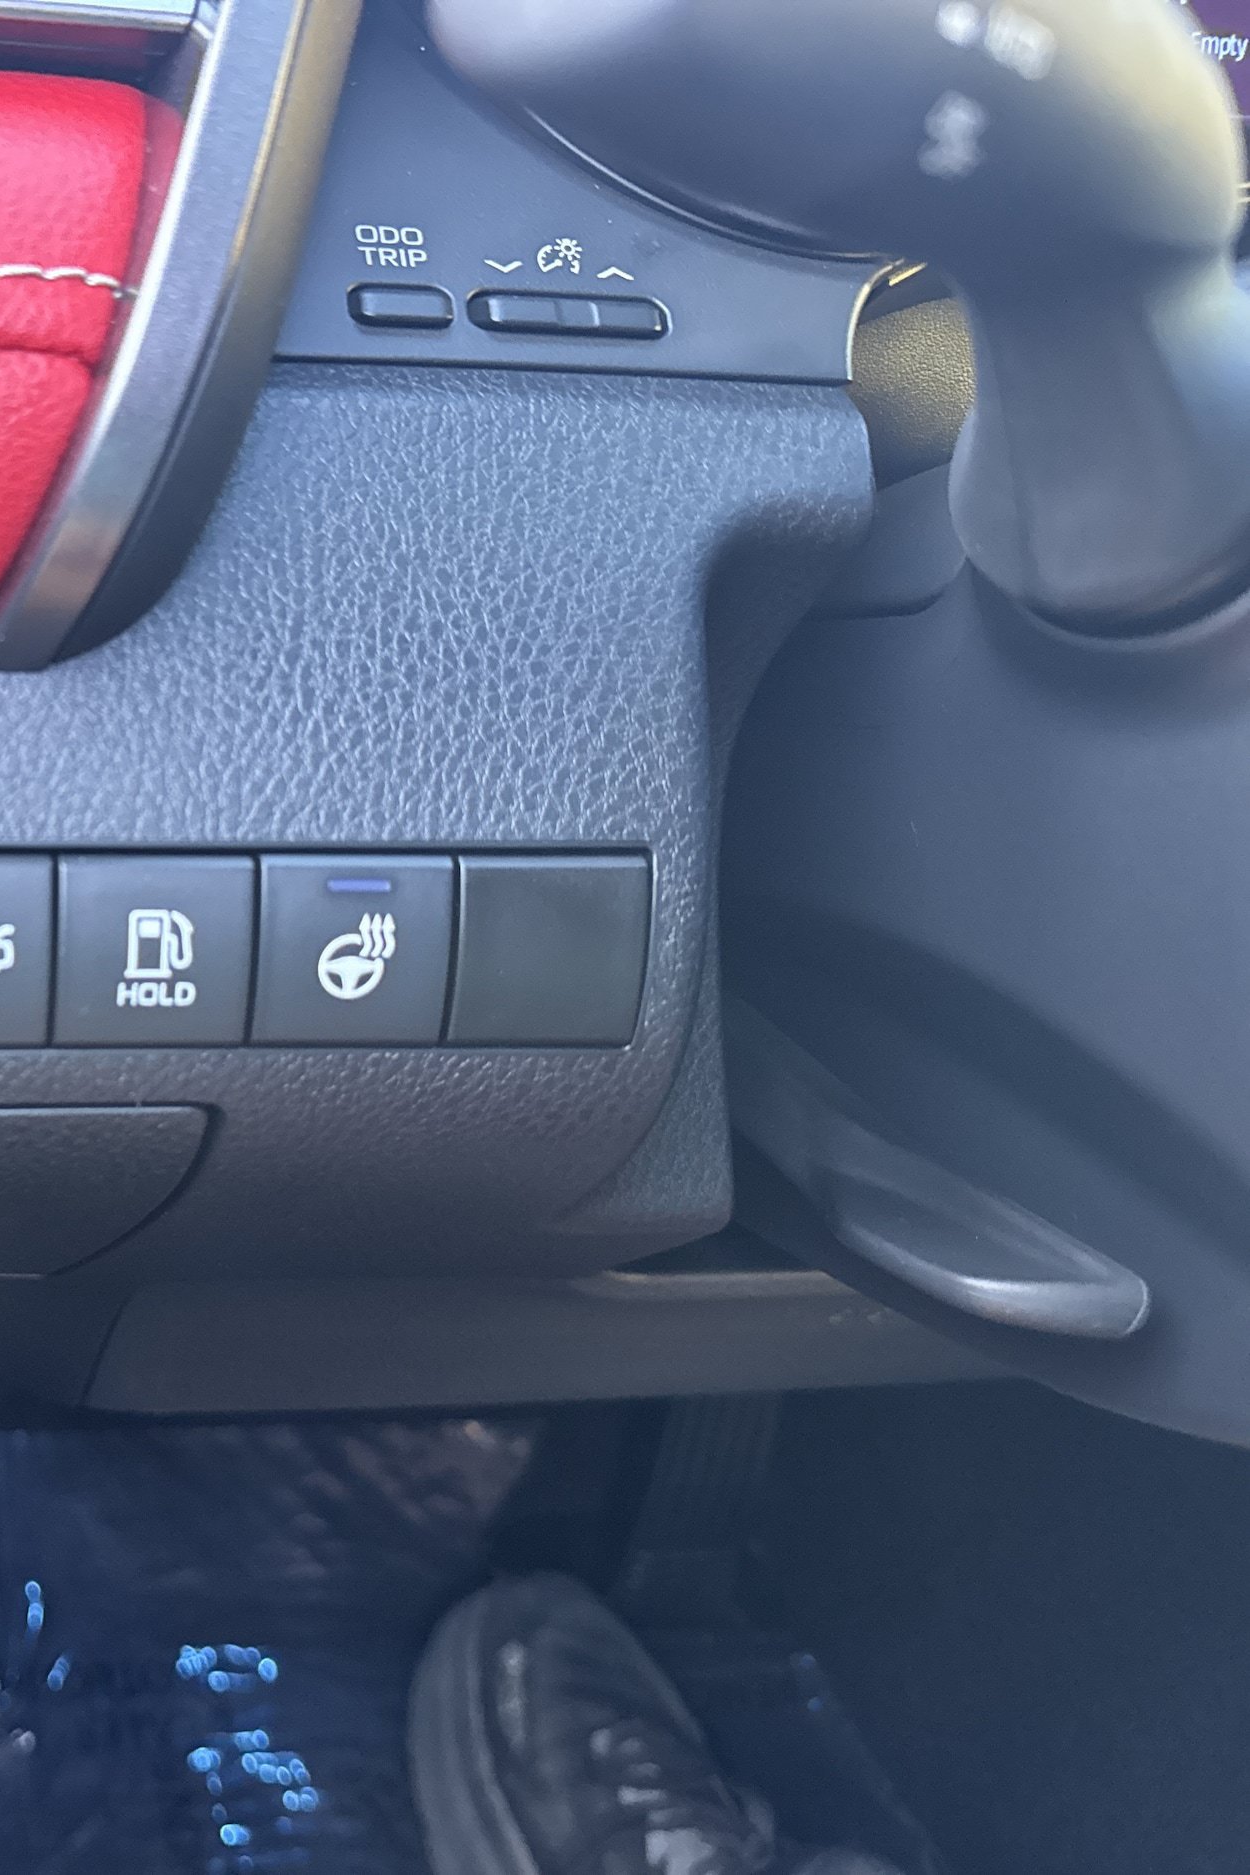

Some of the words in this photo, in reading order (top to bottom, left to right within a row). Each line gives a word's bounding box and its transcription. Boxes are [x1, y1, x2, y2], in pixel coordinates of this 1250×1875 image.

[354, 224, 424, 246] ODO
[357, 246, 428, 268] TRIP
[116, 981, 197, 1008] HOLD
